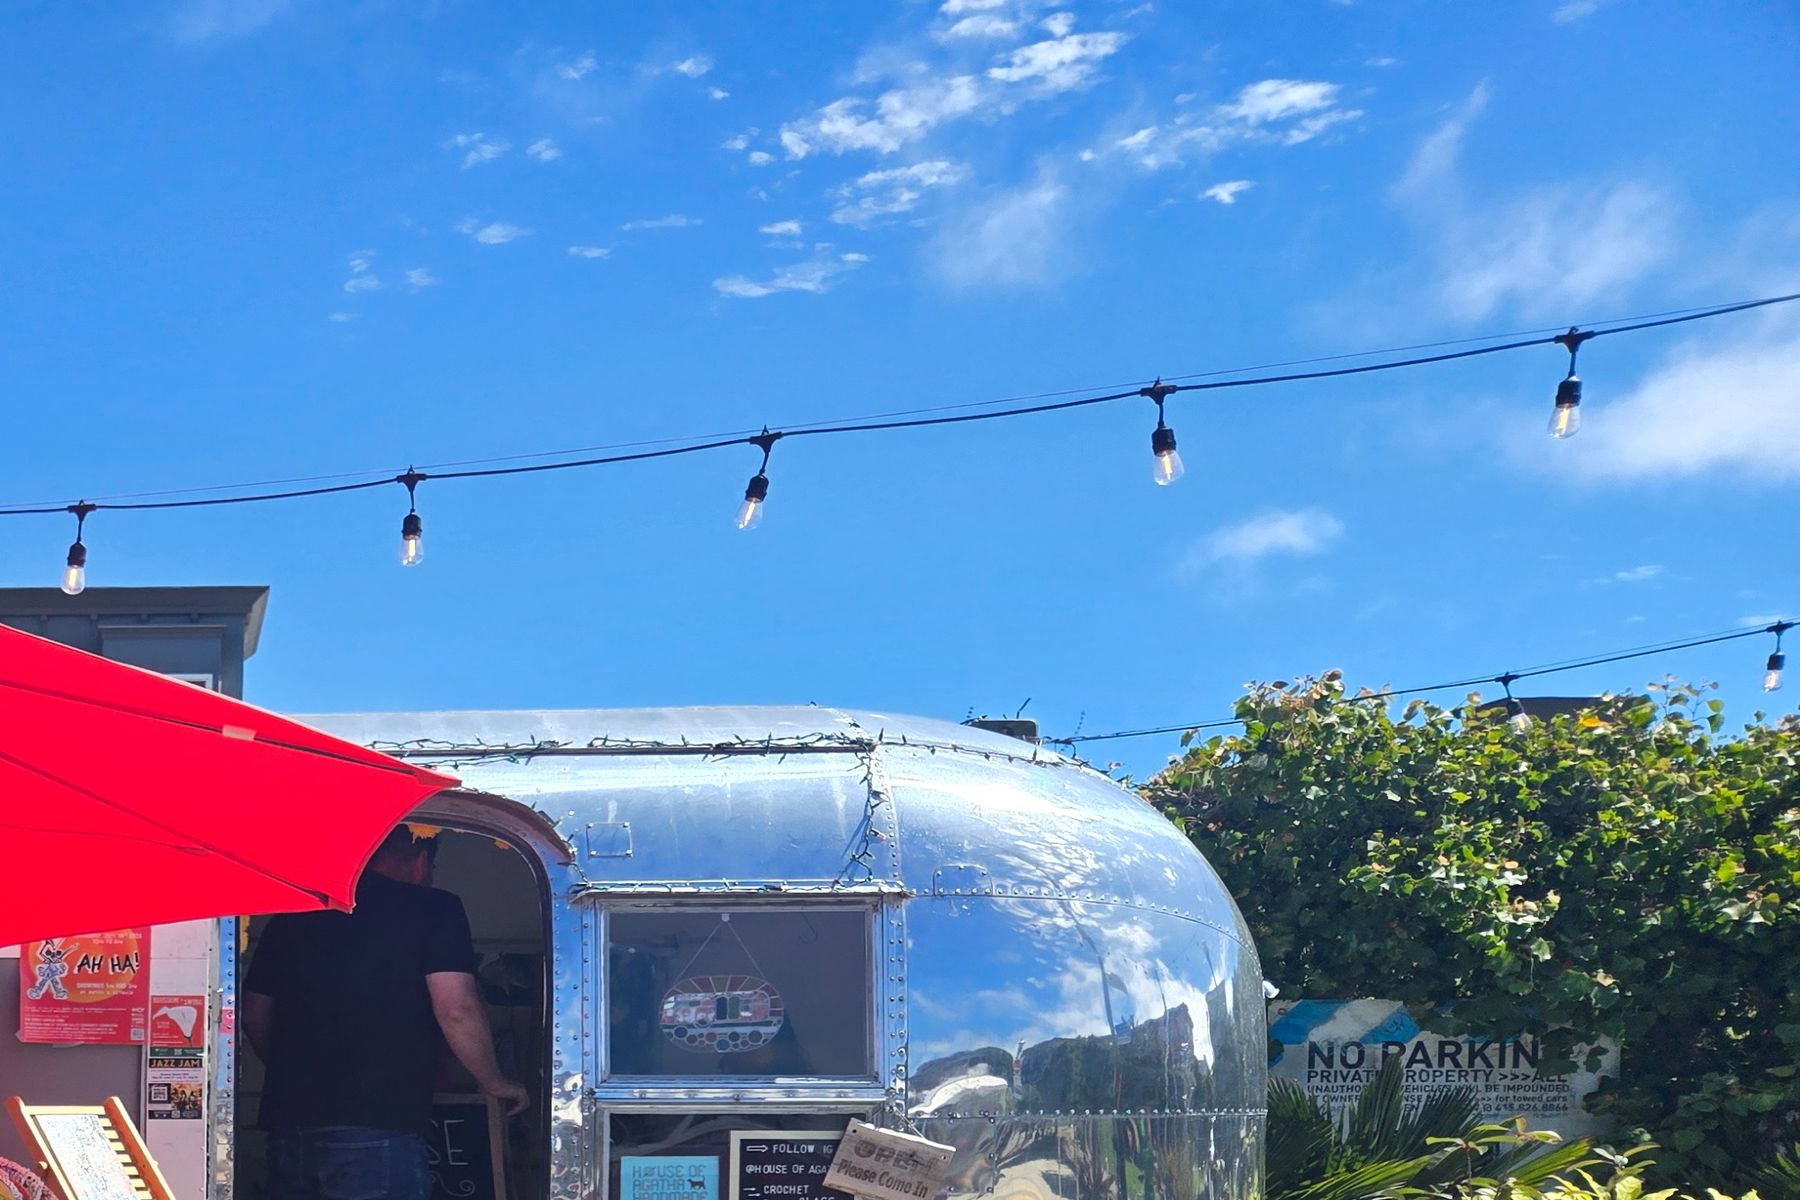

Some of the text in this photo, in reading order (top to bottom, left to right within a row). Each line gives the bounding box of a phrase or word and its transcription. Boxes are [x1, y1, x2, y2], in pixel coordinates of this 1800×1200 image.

[75, 952, 140, 975] AH HA!
[1307, 1040, 1539, 1069] NO PARKIN
[151, 1059, 201, 1068] JAZZ JAM
[1404, 1070, 1493, 1083] ROPERTY
[1485, 1084, 1500, 1093] BE
[1503, 1084, 1570, 1093] IMPOUNDED
[1513, 1094, 1544, 1102] towed
[772, 1144, 833, 1154] FOLLOW IG
[792, 1164, 806, 1174] OF
[836, 1158, 929, 1200] Please Come In
[632, 1179, 686, 1192] AGATHA
[763, 1184, 809, 1195] CROCHET
